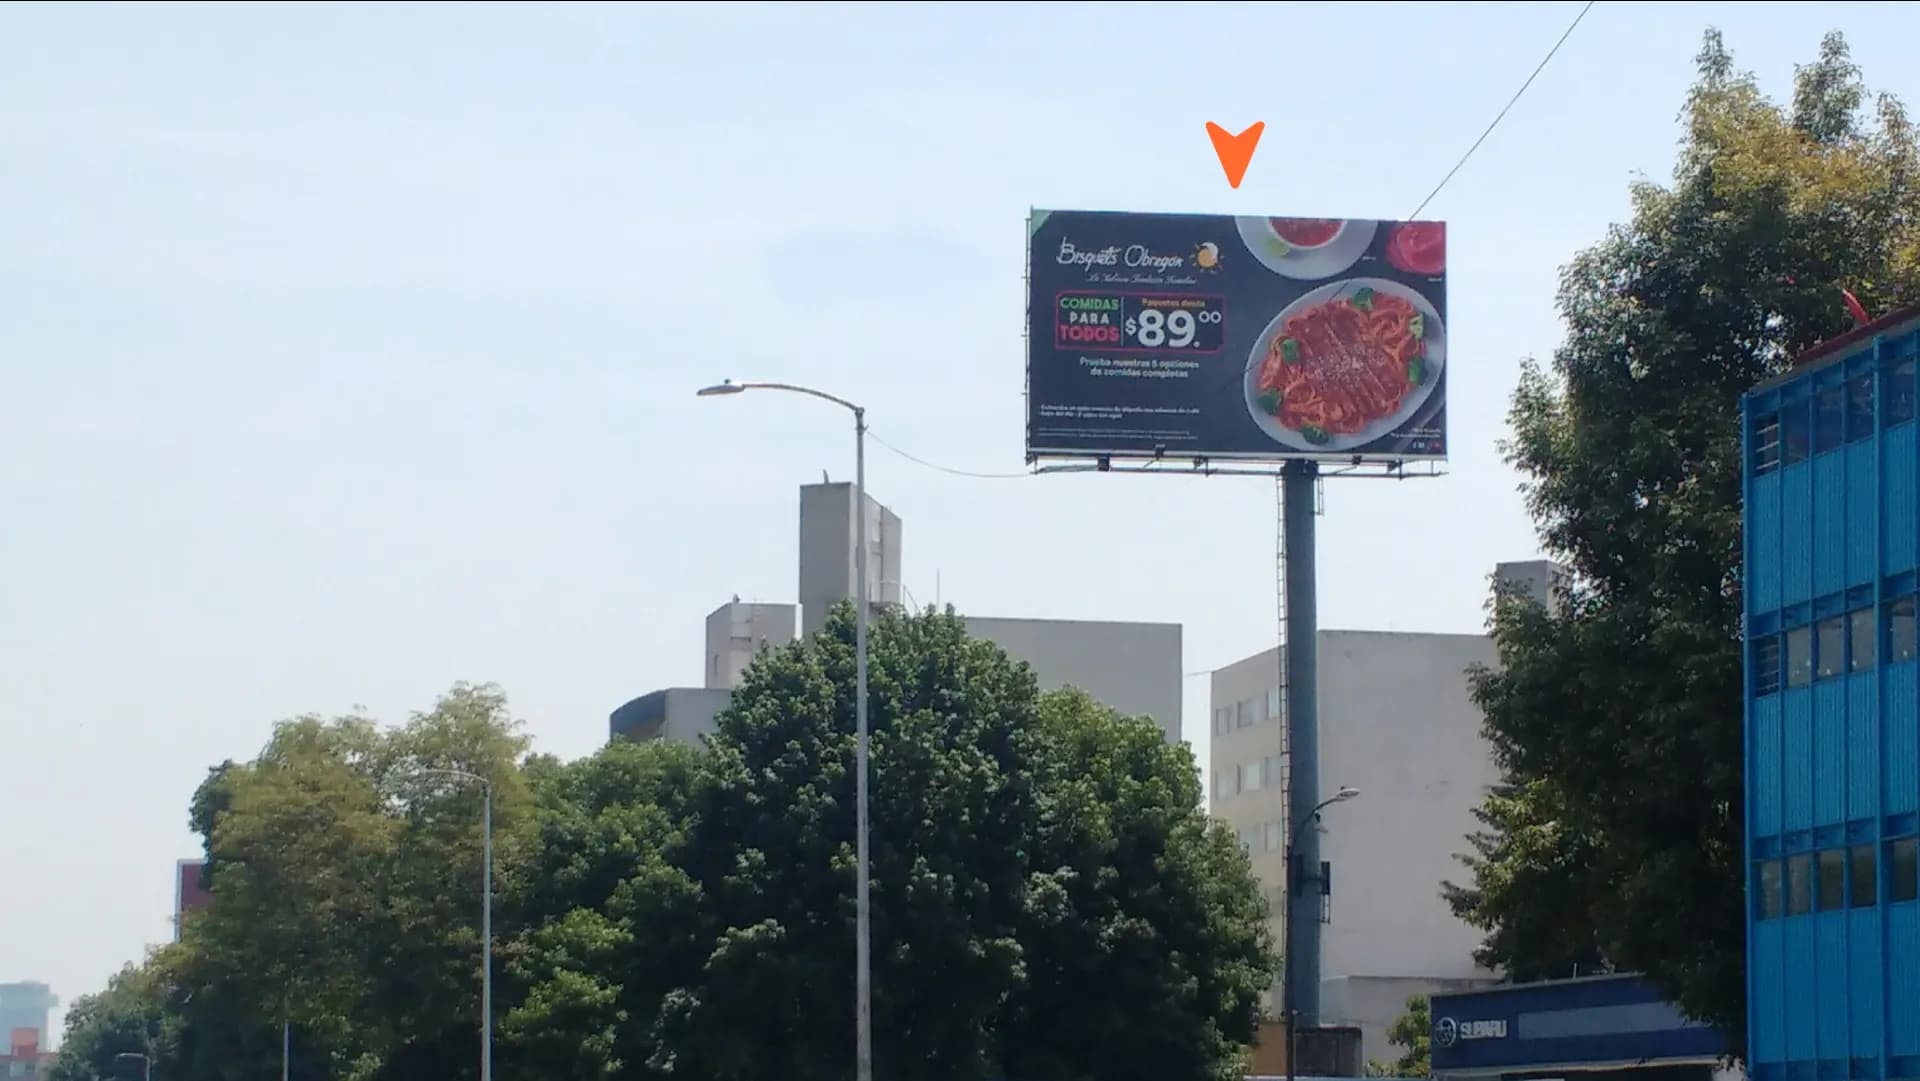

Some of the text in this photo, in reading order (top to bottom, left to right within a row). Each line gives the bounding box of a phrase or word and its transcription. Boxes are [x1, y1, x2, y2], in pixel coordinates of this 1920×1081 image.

[1060, 297, 1119, 310] COMIDAS
[1069, 311, 1110, 325] PARA
[1060, 325, 1120, 342] TODOS
[1080, 356, 1111, 367] Prueba
[1112, 359, 1150, 367] nuestras
[1159, 360, 1199, 370] opciones
[1090, 367, 1188, 378] de comidas completas
